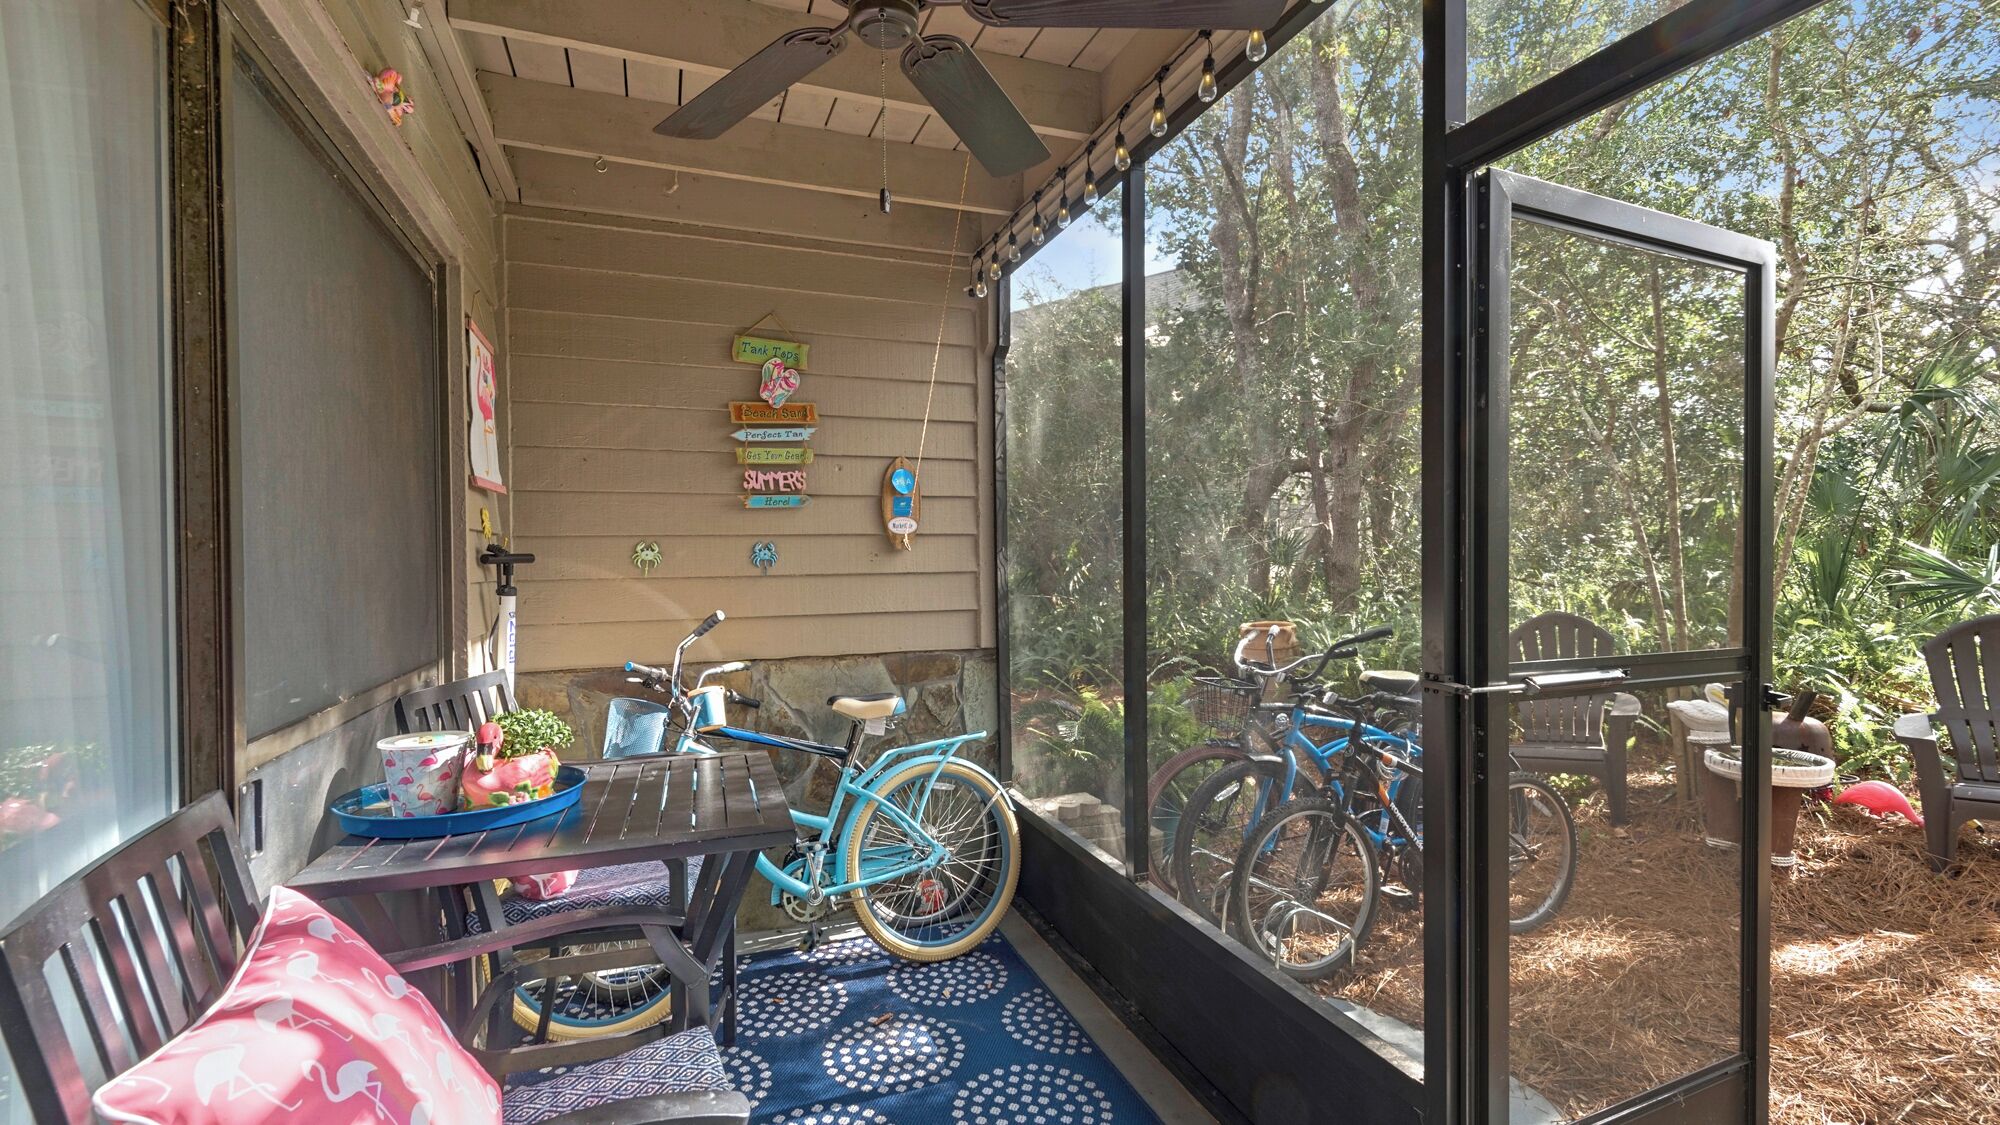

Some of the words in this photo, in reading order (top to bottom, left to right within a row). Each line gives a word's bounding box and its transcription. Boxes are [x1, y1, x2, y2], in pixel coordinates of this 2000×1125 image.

[741, 341, 768, 356] Tank
[772, 346, 800, 362] Tops
[743, 408, 778, 419] Beach
[781, 408, 808, 419] Sand
[744, 431, 782, 440] Perfect
[784, 430, 803, 438] Tan
[746, 450, 761, 460] Get
[764, 450, 783, 460] Your
[784, 450, 805, 460] Gear
